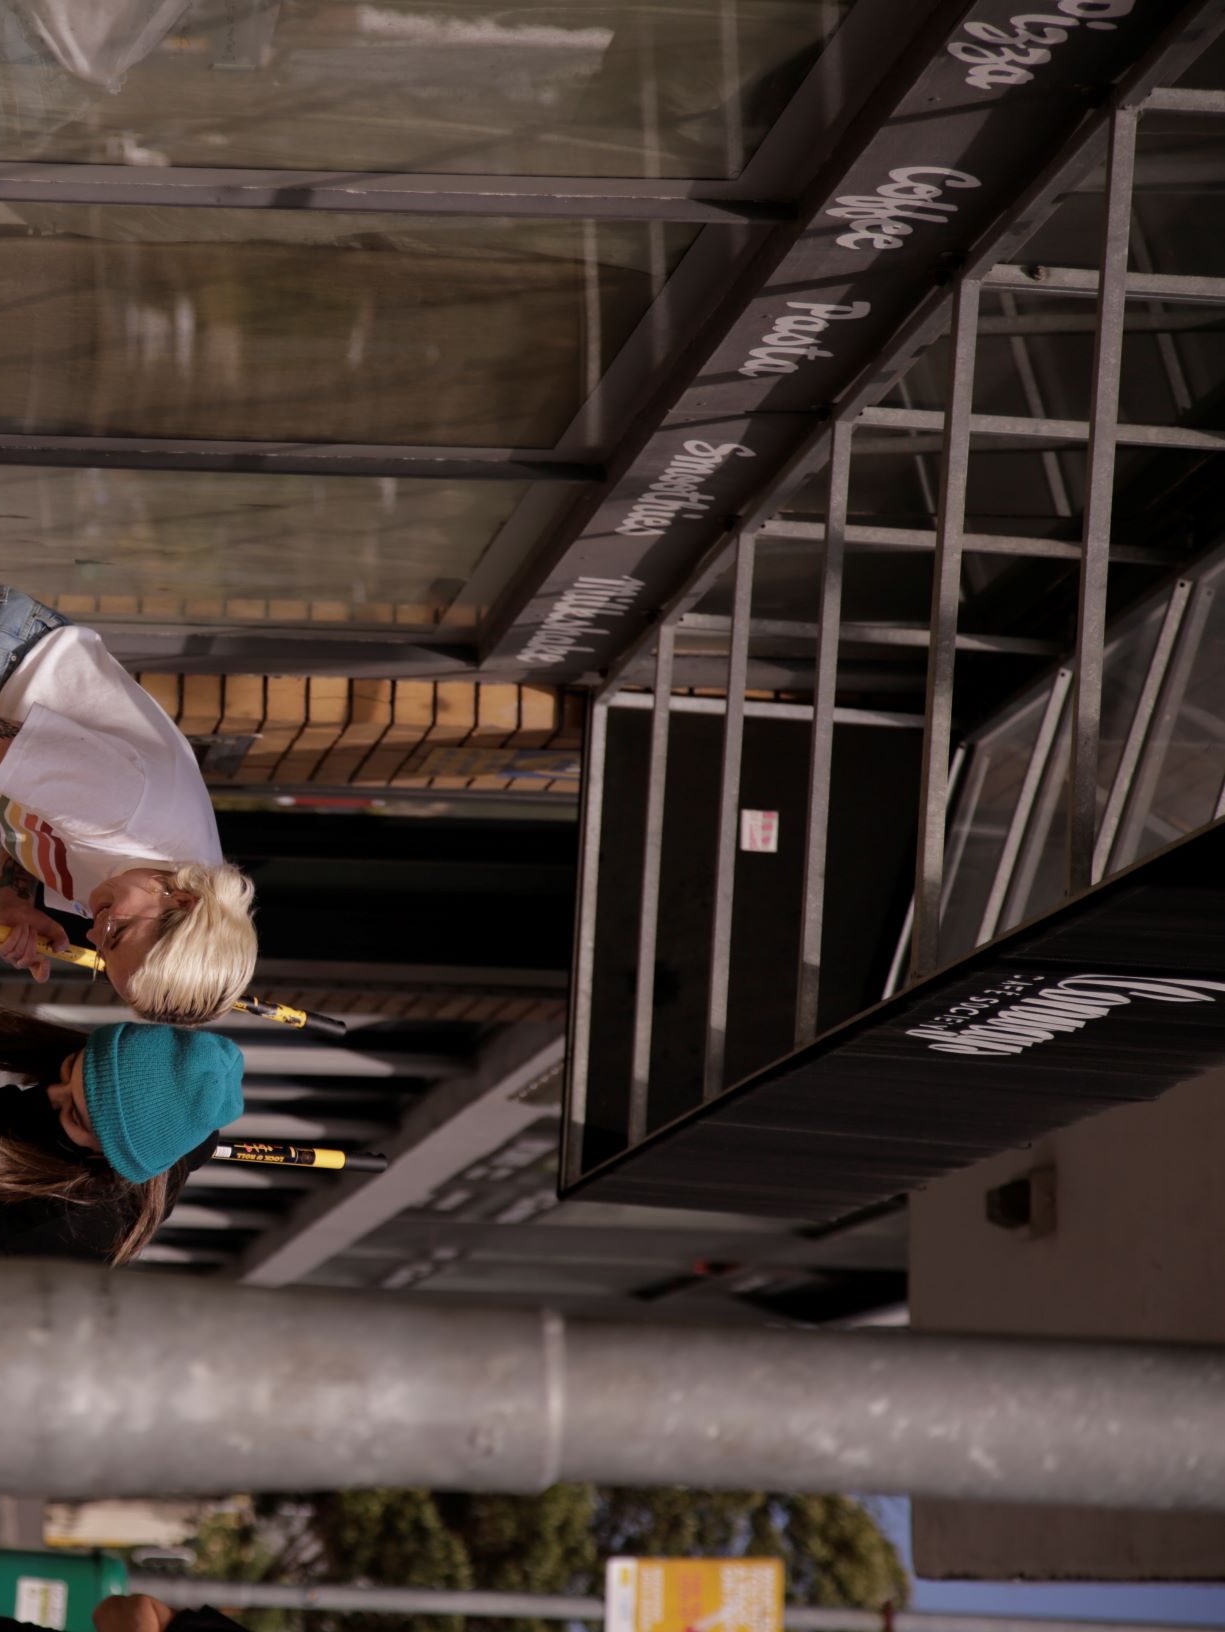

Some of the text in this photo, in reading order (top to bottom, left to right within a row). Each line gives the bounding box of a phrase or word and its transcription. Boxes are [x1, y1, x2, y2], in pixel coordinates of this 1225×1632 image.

[825, 166, 982, 250] Coffee
[738, 301, 871, 377] Pasta
[614, 440, 757, 536] Smoothies
[516, 576, 646, 664] Milkshake
[919, 996, 998, 1031] SOCIETY
